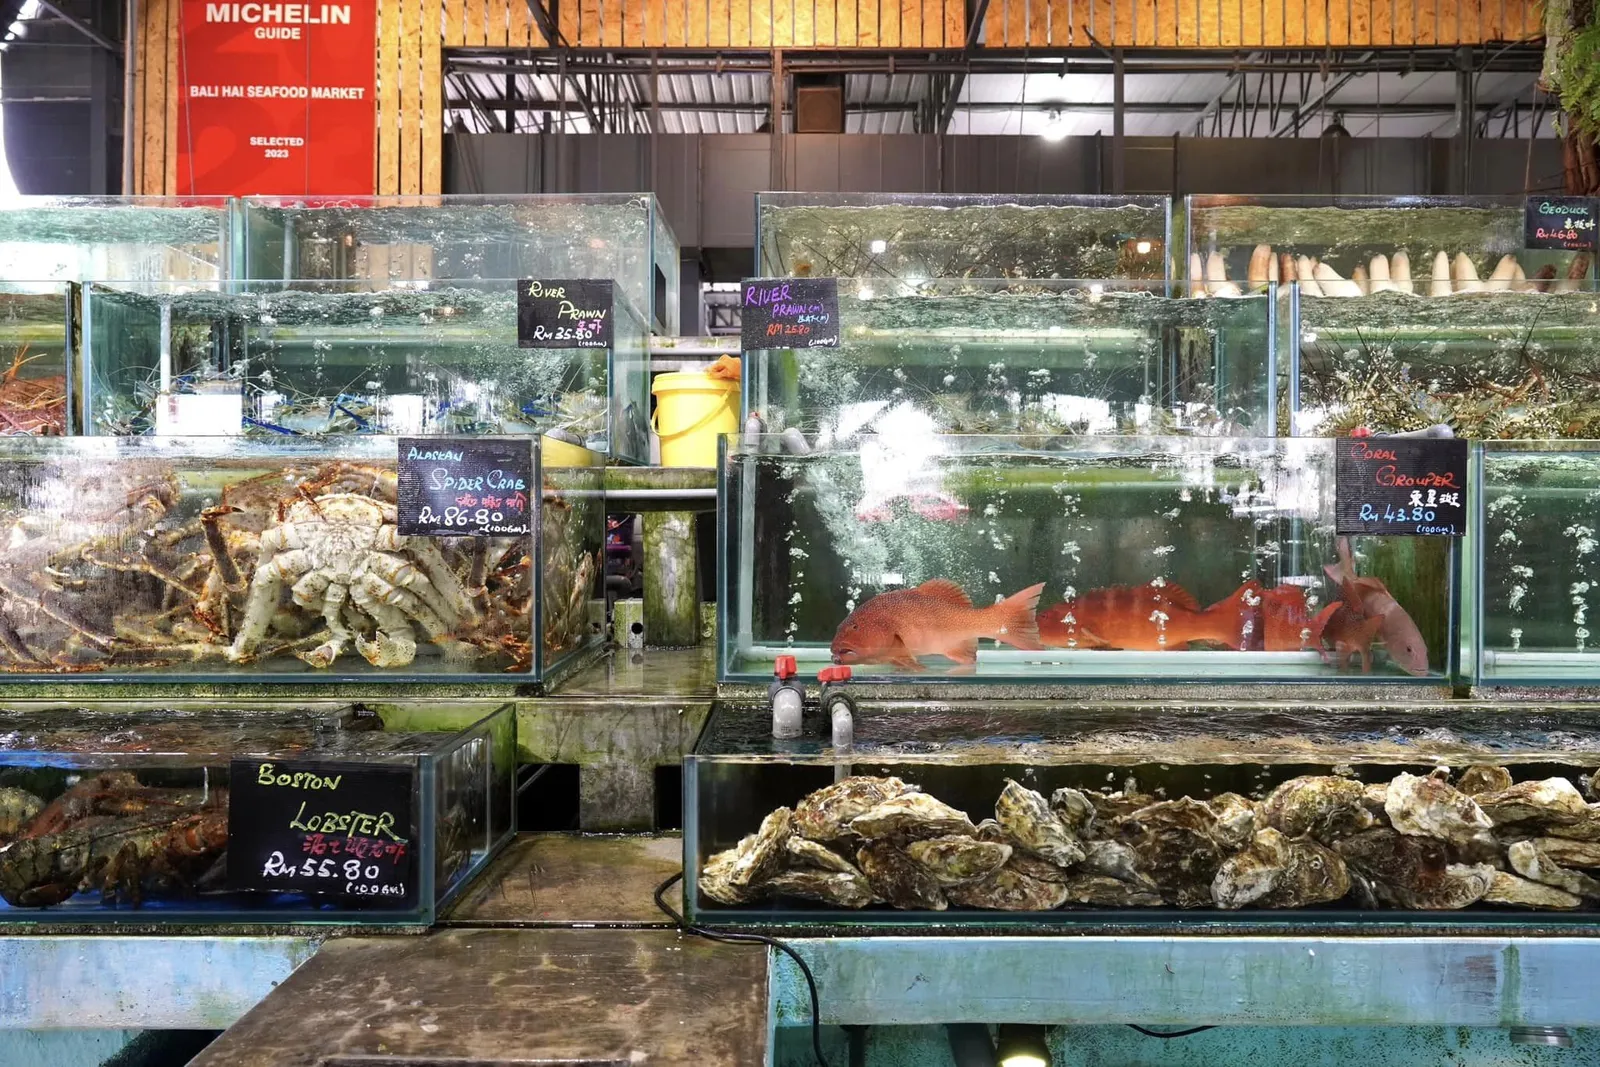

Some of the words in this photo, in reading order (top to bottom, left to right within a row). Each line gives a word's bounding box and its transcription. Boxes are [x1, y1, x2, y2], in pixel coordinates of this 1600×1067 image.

[206, 3, 351, 24] MICHELIN
[254, 27, 301, 40] GUIDE
[190, 86, 218, 97] BALI
[222, 86, 244, 97] HAI
[247, 86, 308, 98] SEAFOOD
[311, 87, 365, 99] MARKET
[250, 136, 304, 146] SELECTED
[265, 149, 289, 158] 2023
[528, 281, 566, 299] RIVER
[746, 284, 792, 306] RIVER
[558, 300, 606, 320] PRAWN
[407, 446, 464, 462] ALASKAN
[1351, 442, 1397, 460] CORAL
[429, 468, 483, 491] SPIDER
[487, 469, 525, 490] CRAB
[1376, 465, 1460, 489] GROUPER
[1384, 504, 1435, 523] 43.80
[257, 763, 342, 790] BOSTON
[289, 801, 408, 842] LOBSTER
[300, 858, 379, 880] 55.80
